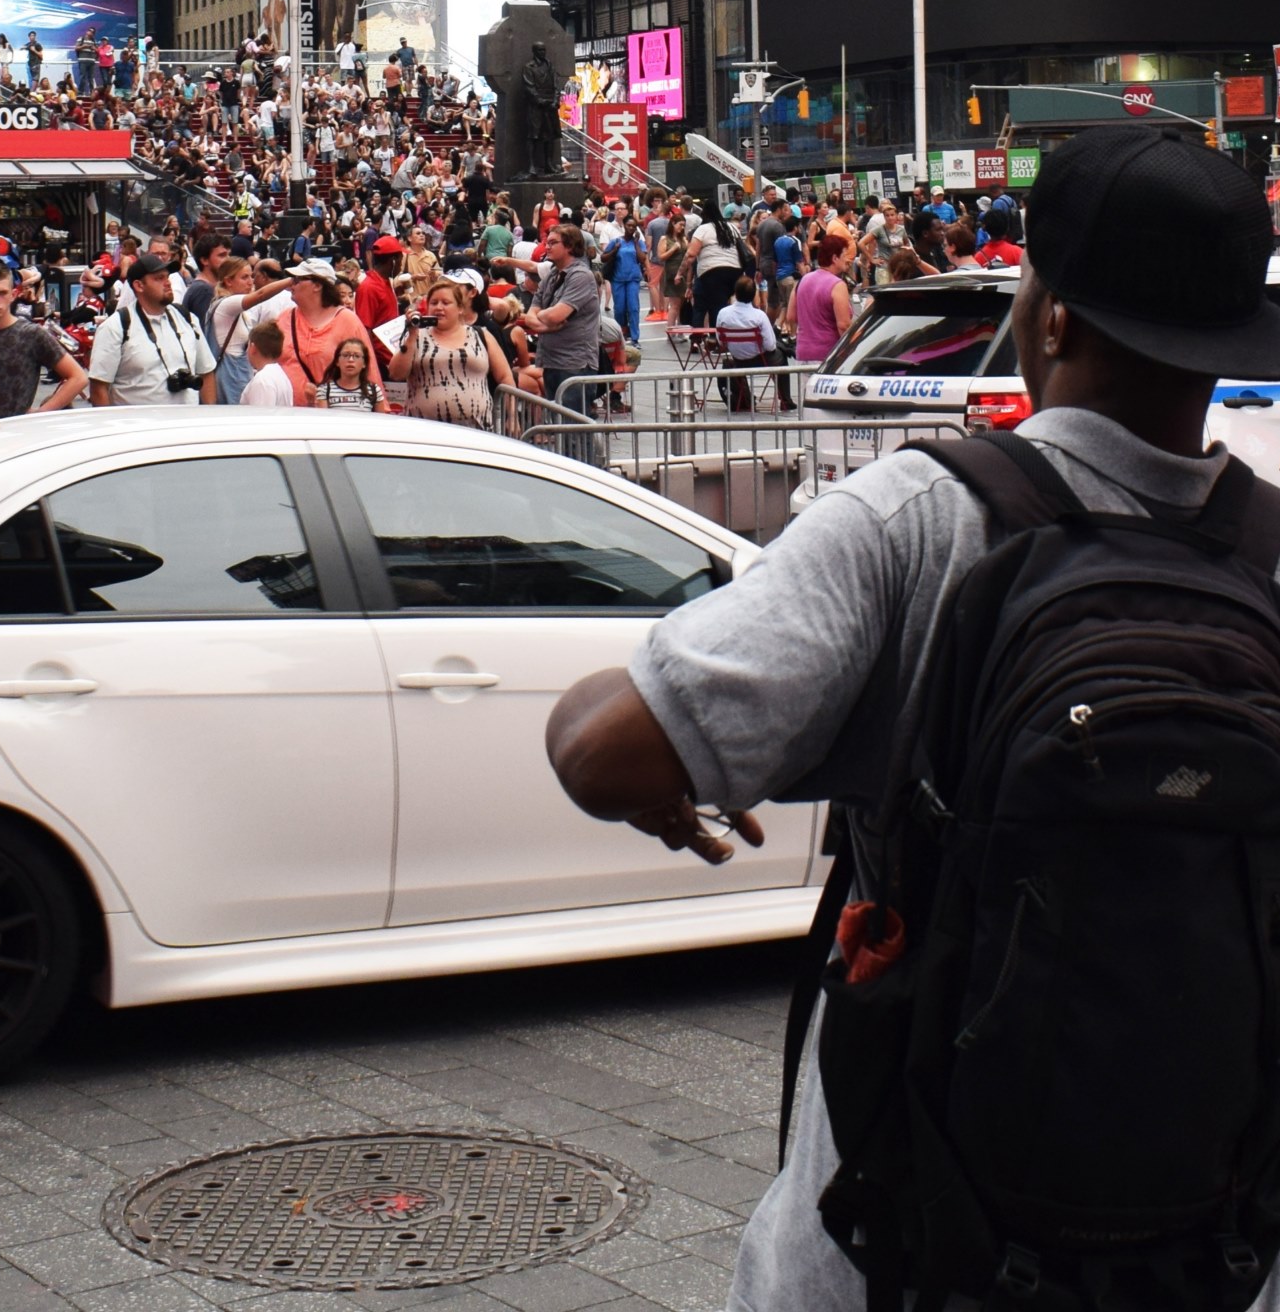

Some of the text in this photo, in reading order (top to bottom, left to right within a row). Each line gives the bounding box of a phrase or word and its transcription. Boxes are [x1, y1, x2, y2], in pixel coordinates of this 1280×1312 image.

[1123, 92, 1153, 107] CNY
[602, 110, 639, 187] tkts
[705, 150, 739, 178] NORTH SHORE
[978, 157, 1005, 166] STEP
[1011, 160, 1035, 169] NOV
[978, 171, 1005, 179] GAME
[1011, 168, 1037, 178] 2017
[878, 379, 945, 398] POLICE
